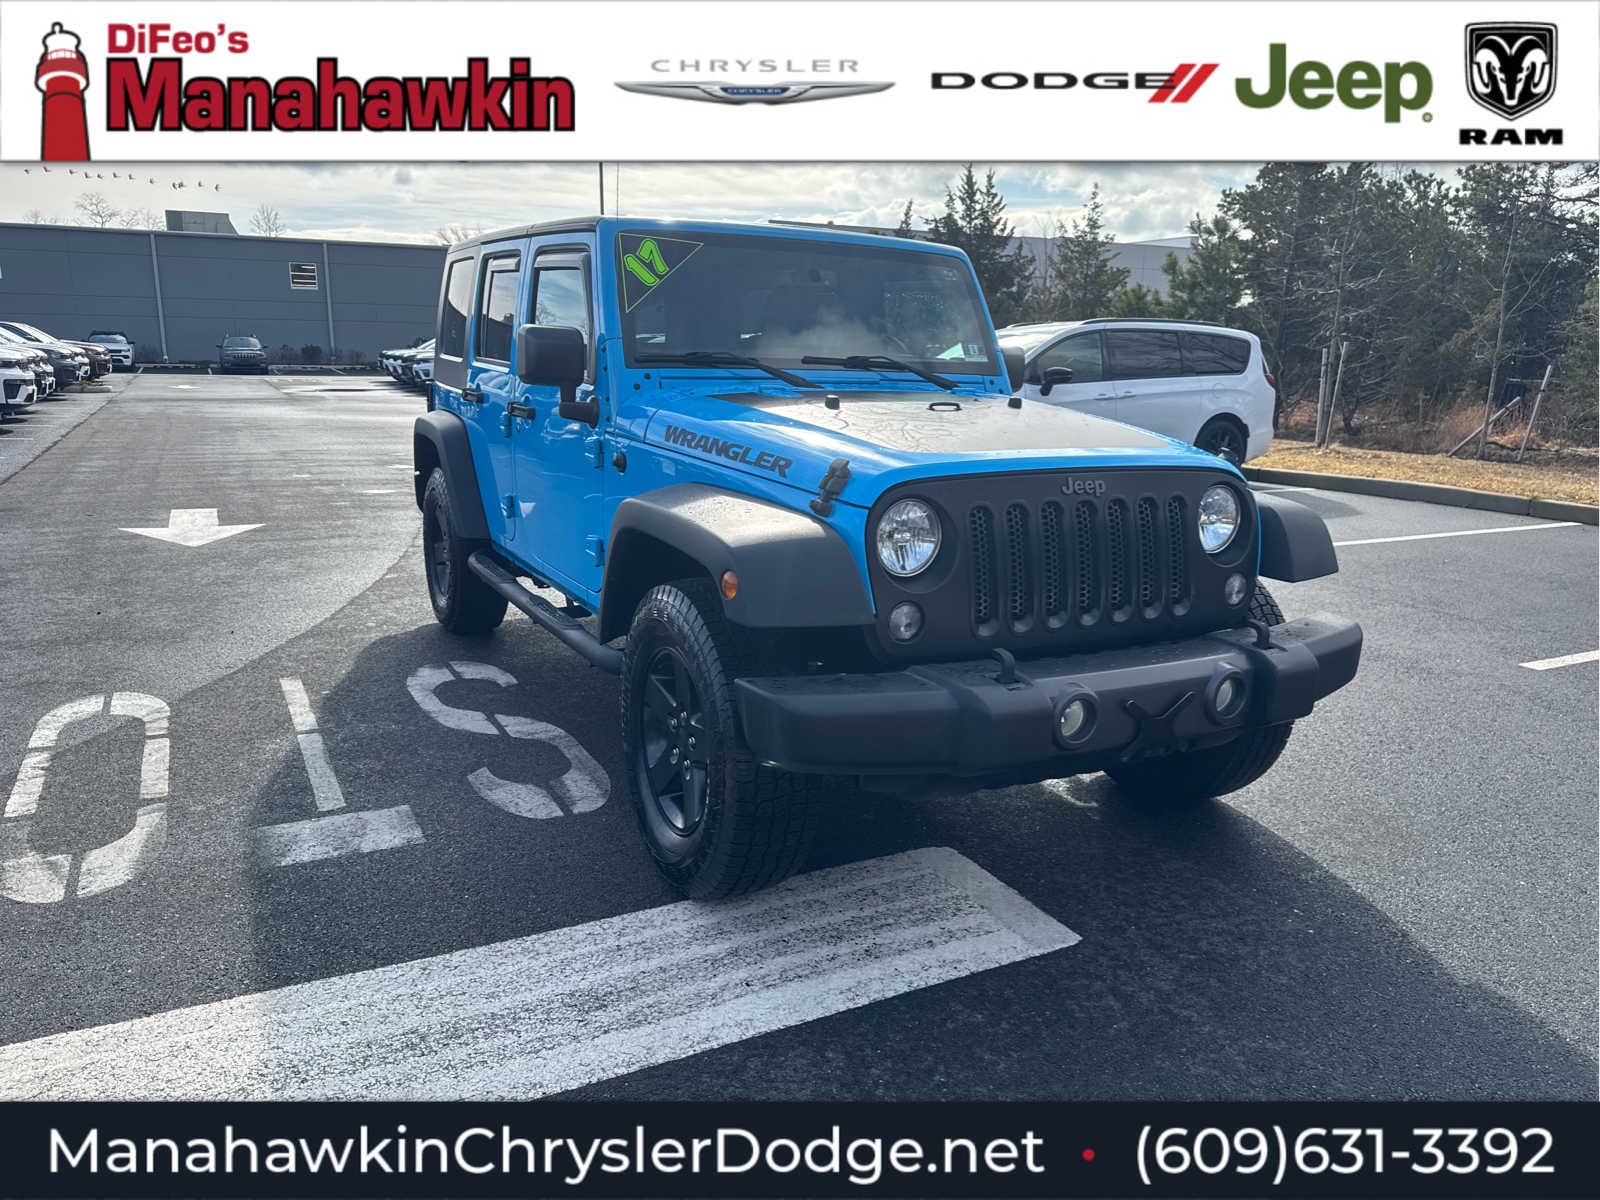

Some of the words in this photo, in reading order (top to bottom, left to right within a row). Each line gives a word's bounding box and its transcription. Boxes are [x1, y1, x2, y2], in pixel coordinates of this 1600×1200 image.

[624, 238, 669, 286] 17
[663, 424, 793, 478] WRANGLER
[1061, 476, 1106, 497] Jeep
